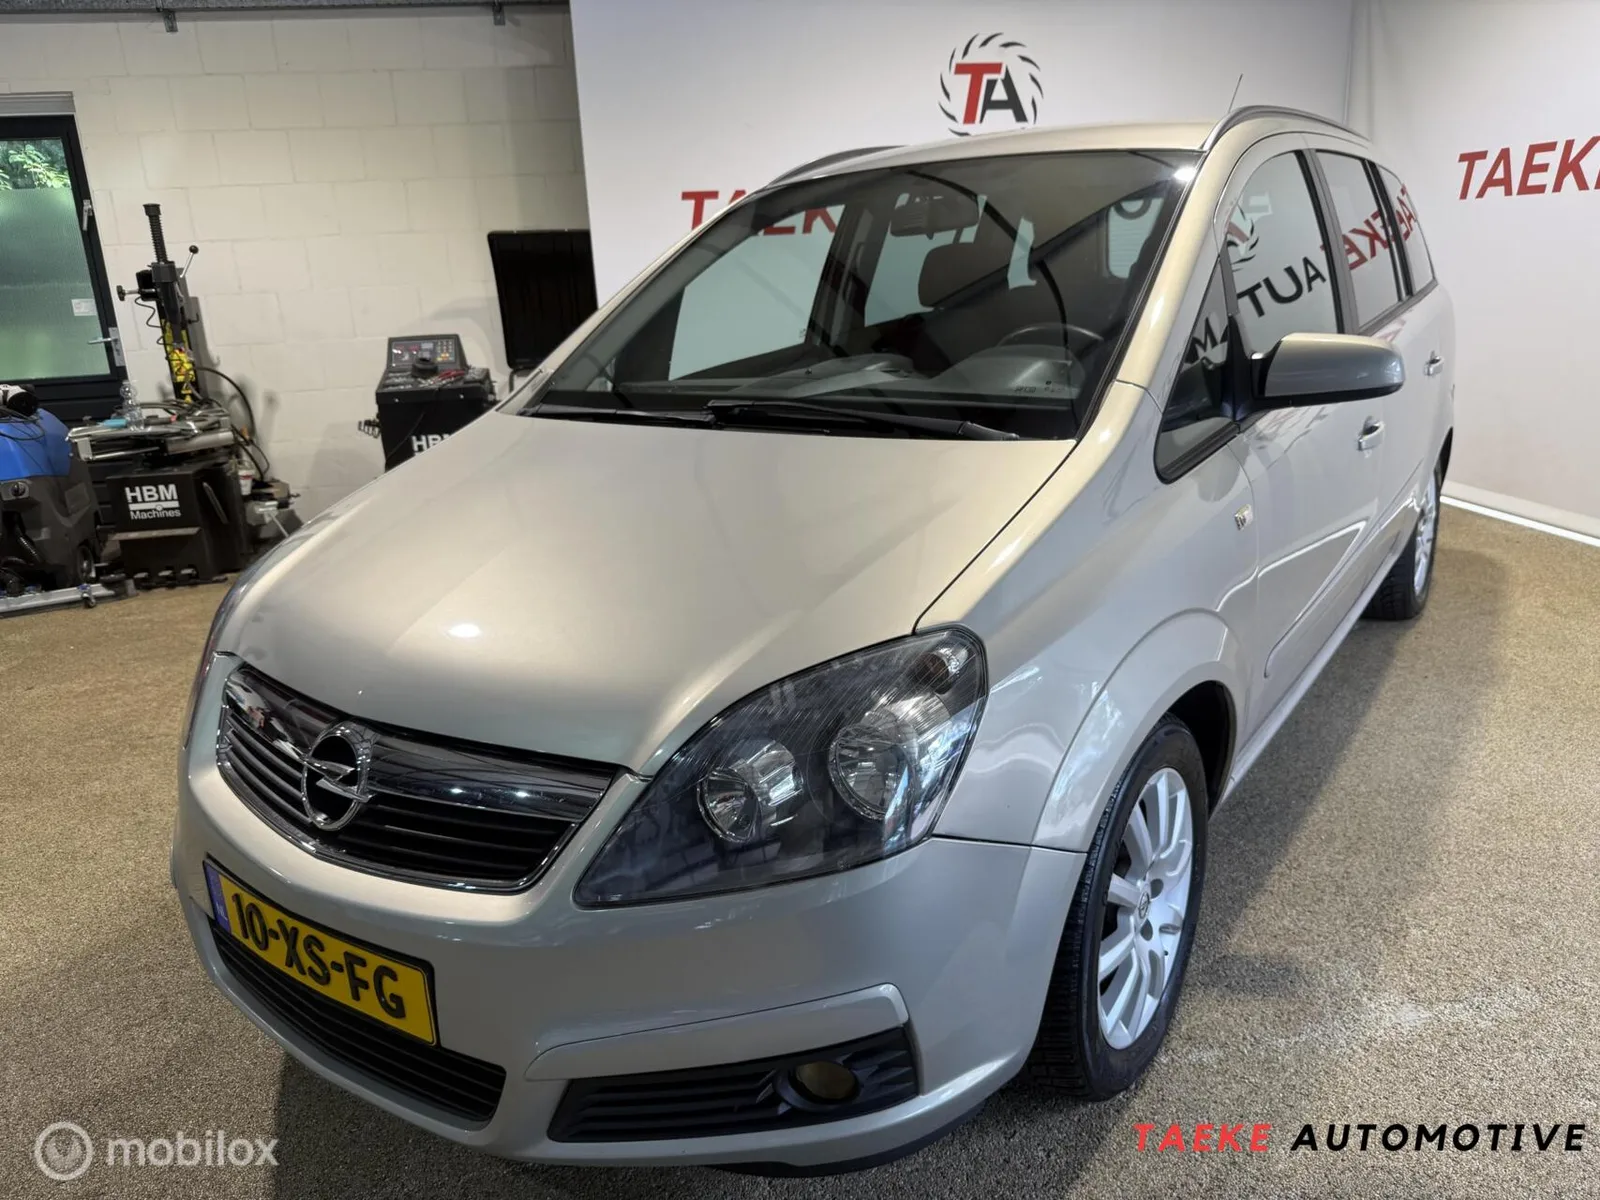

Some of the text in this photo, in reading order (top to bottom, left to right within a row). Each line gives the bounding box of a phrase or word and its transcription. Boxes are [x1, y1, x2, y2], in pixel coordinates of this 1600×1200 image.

[1458, 135, 1600, 200] TAEK
[412, 434, 452, 453] HB
[125, 483, 178, 503] HBM
[130, 508, 181, 520] Machines
[232, 892, 406, 1020] 10-XS-FG
